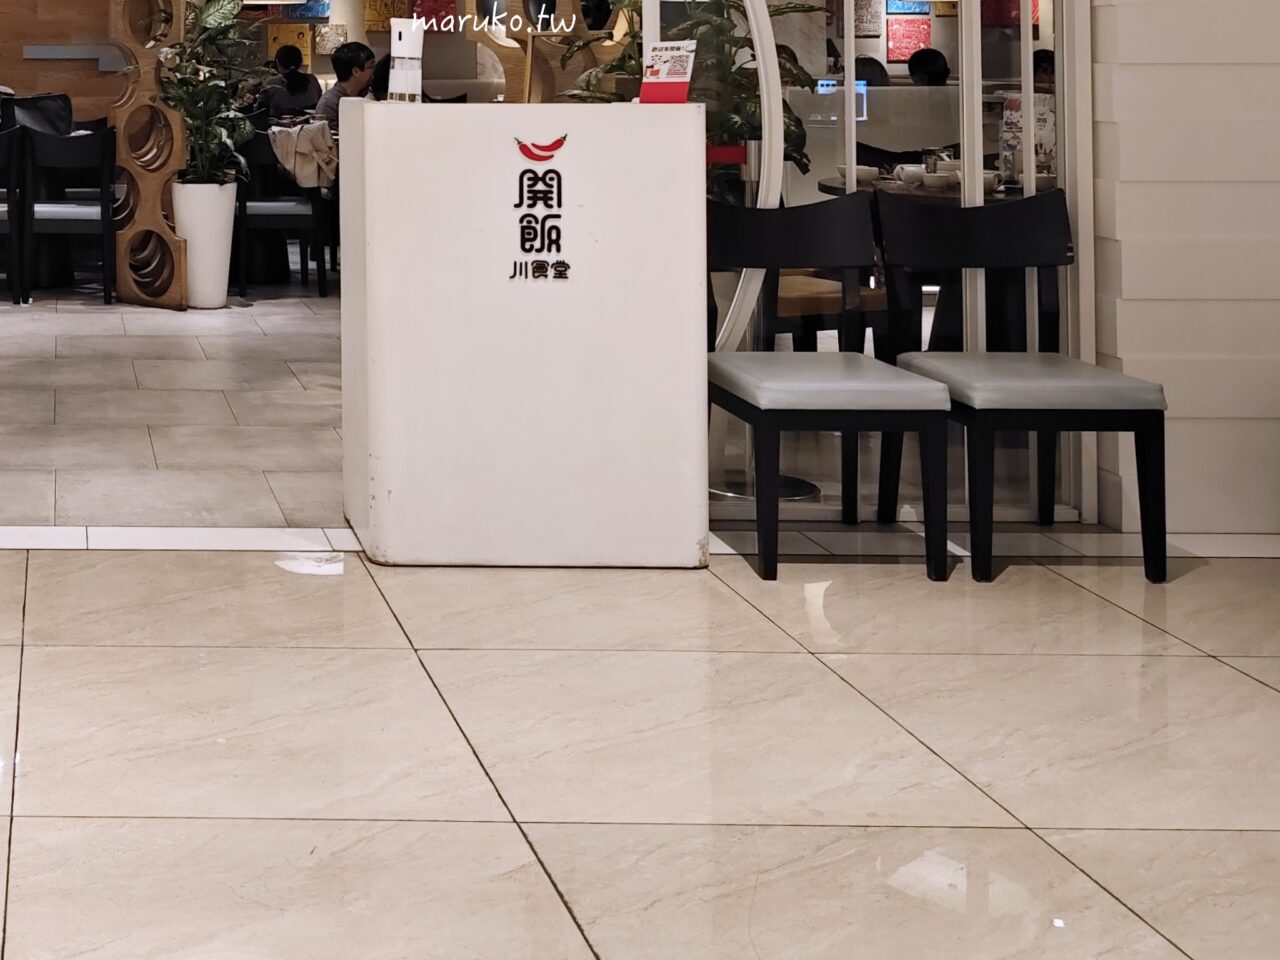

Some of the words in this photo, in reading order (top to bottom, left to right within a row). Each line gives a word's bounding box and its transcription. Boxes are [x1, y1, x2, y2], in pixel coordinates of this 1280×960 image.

[513, 168, 562, 254] 開飯
[509, 260, 571, 280] 川食堂
